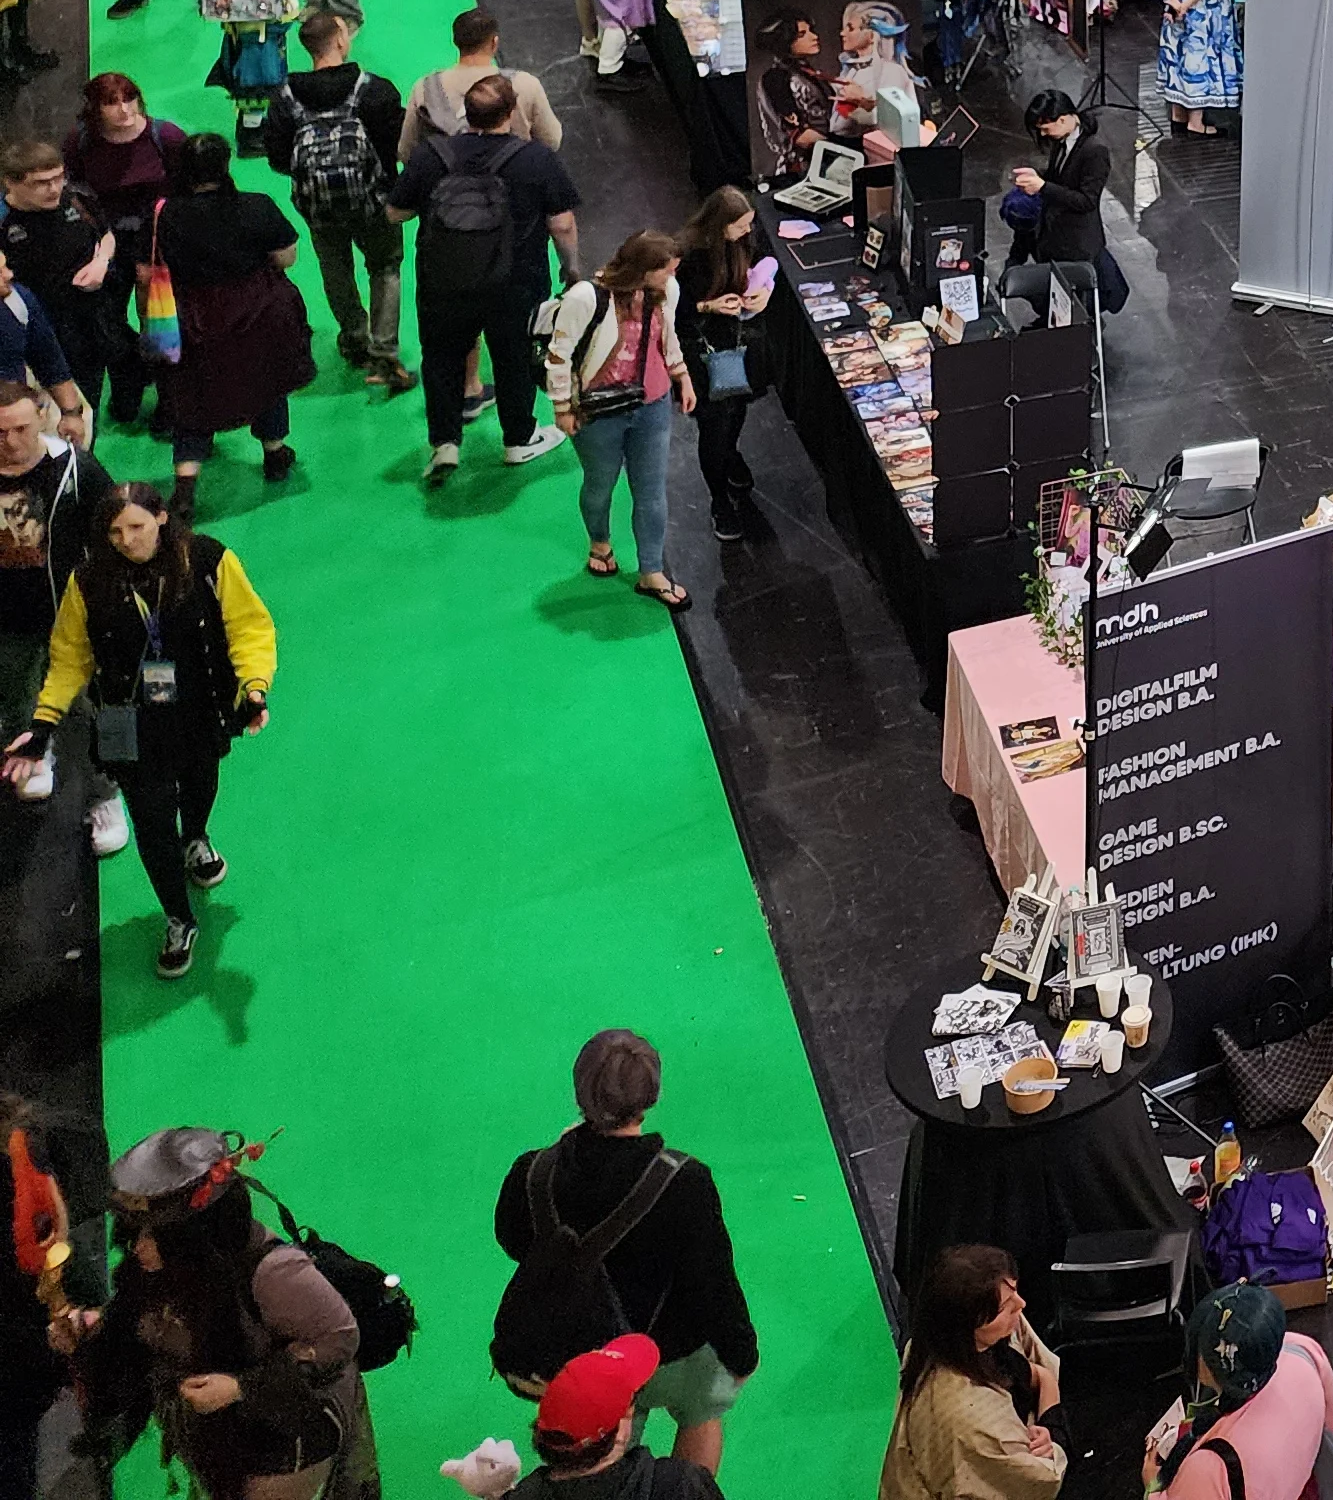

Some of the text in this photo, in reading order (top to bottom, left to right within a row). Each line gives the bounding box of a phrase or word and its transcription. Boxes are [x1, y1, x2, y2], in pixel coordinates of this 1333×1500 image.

[1096, 602, 1159, 637] mdh
[1134, 627, 1143, 636] of
[1143, 618, 1174, 635] Applied
[1174, 609, 1208, 625] Sciences
[1096, 663, 1218, 716] DIGITALFILM
[1097, 686, 1215, 736] DESIGN B.A.
[1098, 741, 1186, 785] FASHION
[1098, 732, 1281, 804] MANAGEMENT B.A.
[1099, 817, 1158, 851] GAME
[1100, 815, 1228, 871] DESIGN B.SC.
[1117, 878, 1174, 910] EDIEN
[1124, 885, 1216, 928] SIGN B.A.
[1231, 921, 1278, 956] (IHK)
